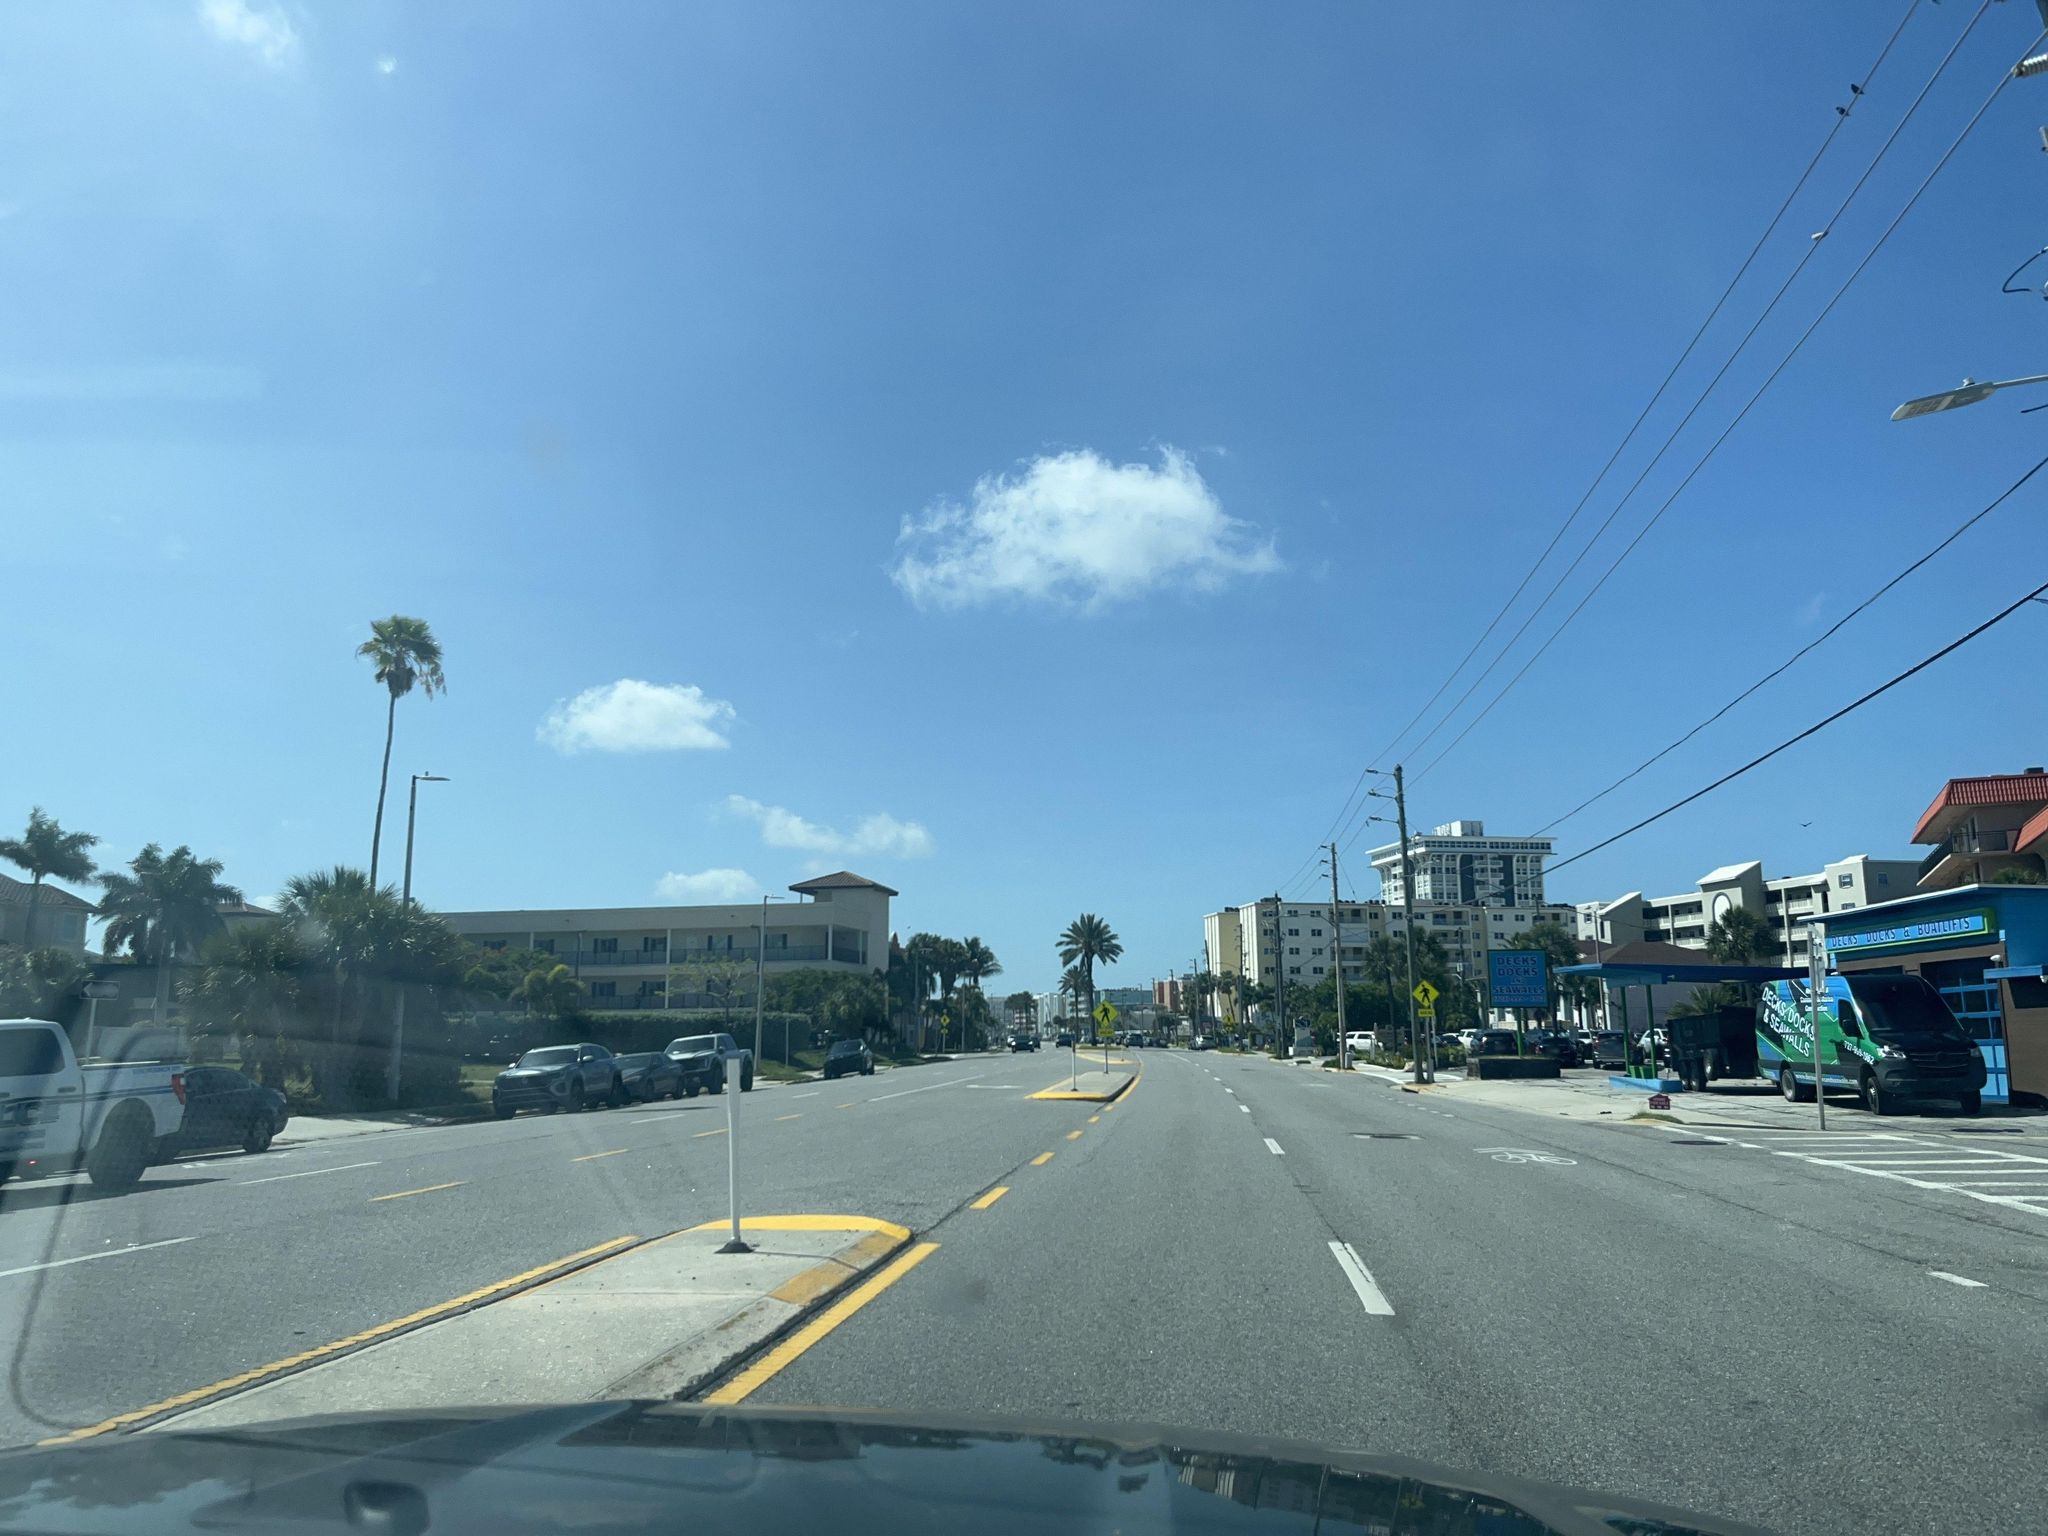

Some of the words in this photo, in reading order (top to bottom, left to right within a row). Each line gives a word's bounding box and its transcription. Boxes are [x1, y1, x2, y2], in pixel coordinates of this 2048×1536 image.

[1832, 934, 1858, 948] DECKS
[1866, 927, 1896, 943] DOCKS
[1903, 926, 1910, 938] &
[1917, 917, 1970, 936] BOATLIFTS
[1496, 956, 1537, 966] DECKS
[1497, 967, 1538, 977] DOCKS
[1493, 985, 1545, 994] SEAWALLS
[1763, 1008, 1769, 1023] &
[1769, 1013, 1810, 1057] SEAWALLS
[1787, 1007, 1815, 1041] DOCKS
